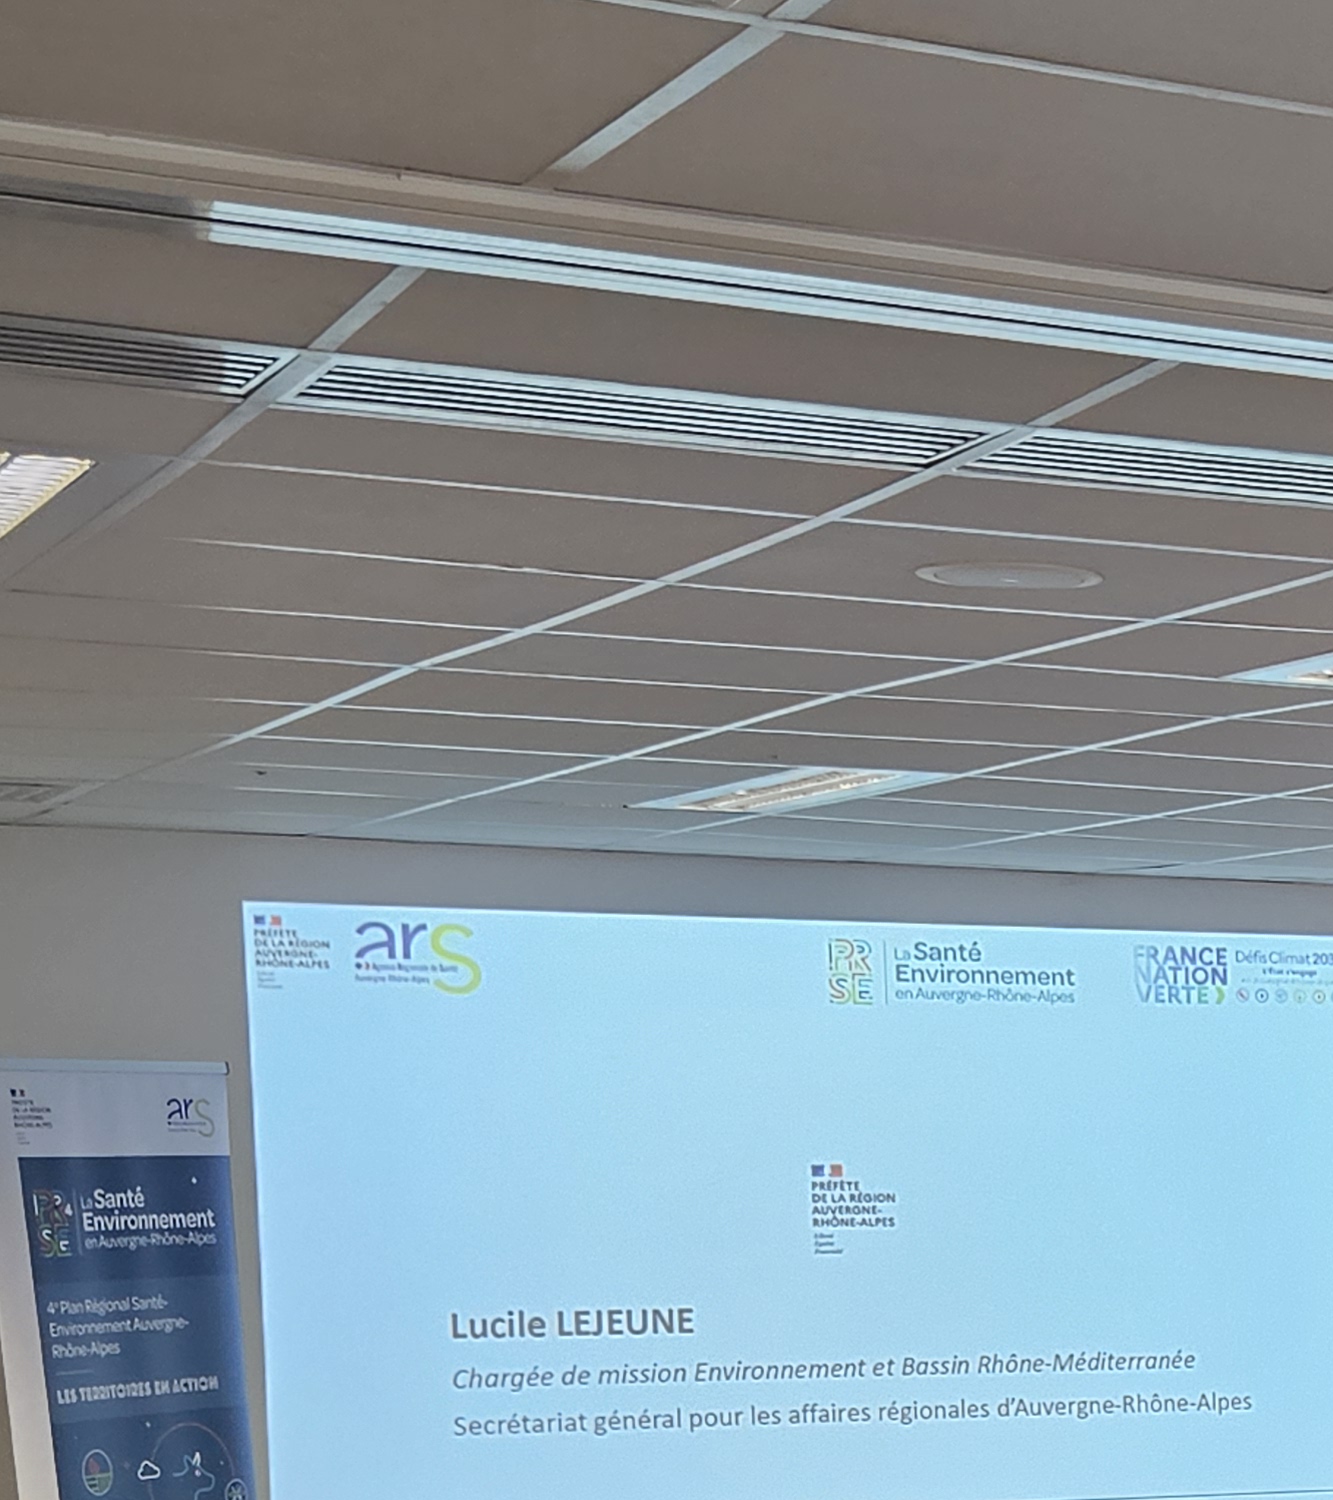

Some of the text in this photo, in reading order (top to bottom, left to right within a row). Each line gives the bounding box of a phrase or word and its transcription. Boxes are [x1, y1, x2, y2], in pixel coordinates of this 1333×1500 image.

[355, 920, 482, 994] ars
[894, 941, 982, 962] La Santé
[1133, 945, 1228, 967] FRANCE
[1235, 950, 1267, 964] Défis
[1269, 951, 1311, 965] Climat
[895, 963, 1076, 986] Environnement
[1134, 965, 1228, 986] NATION
[895, 987, 1076, 1005] en Auvergne-Rhône-Alpes
[1136, 984, 1210, 1005] VERTE
[167, 1098, 214, 1138] ars
[811, 1180, 860, 1191] PRÉFÈTE
[93, 1186, 145, 1210] Santé
[811, 1191, 896, 1203] DE LA RÉGION
[82, 1209, 216, 1232] Environnement
[811, 1205, 883, 1215] AUVERGNE-
[812, 1215, 896, 1228] RHÔNE-ALPES
[99, 1231, 216, 1251] Auvergne-Rhône-Alpes
[60, 1300, 84, 1315] Plan
[85, 1297, 130, 1316] Régional
[49, 1318, 132, 1338] Environnement
[450, 1307, 695, 1340] Lucile LEJEUNE
[51, 1341, 121, 1359] Rhône-Alpes
[452, 1348, 1196, 1393] Chargée de mission Environnement et Bassin Rhône-Méditerranée
[56, 1375, 219, 1405] LES TERRITOIRES EN ACTION
[453, 1391, 1253, 1437] Secrétariat général pour les affaires régionales d'Auvergne-Rhône-Alpes
